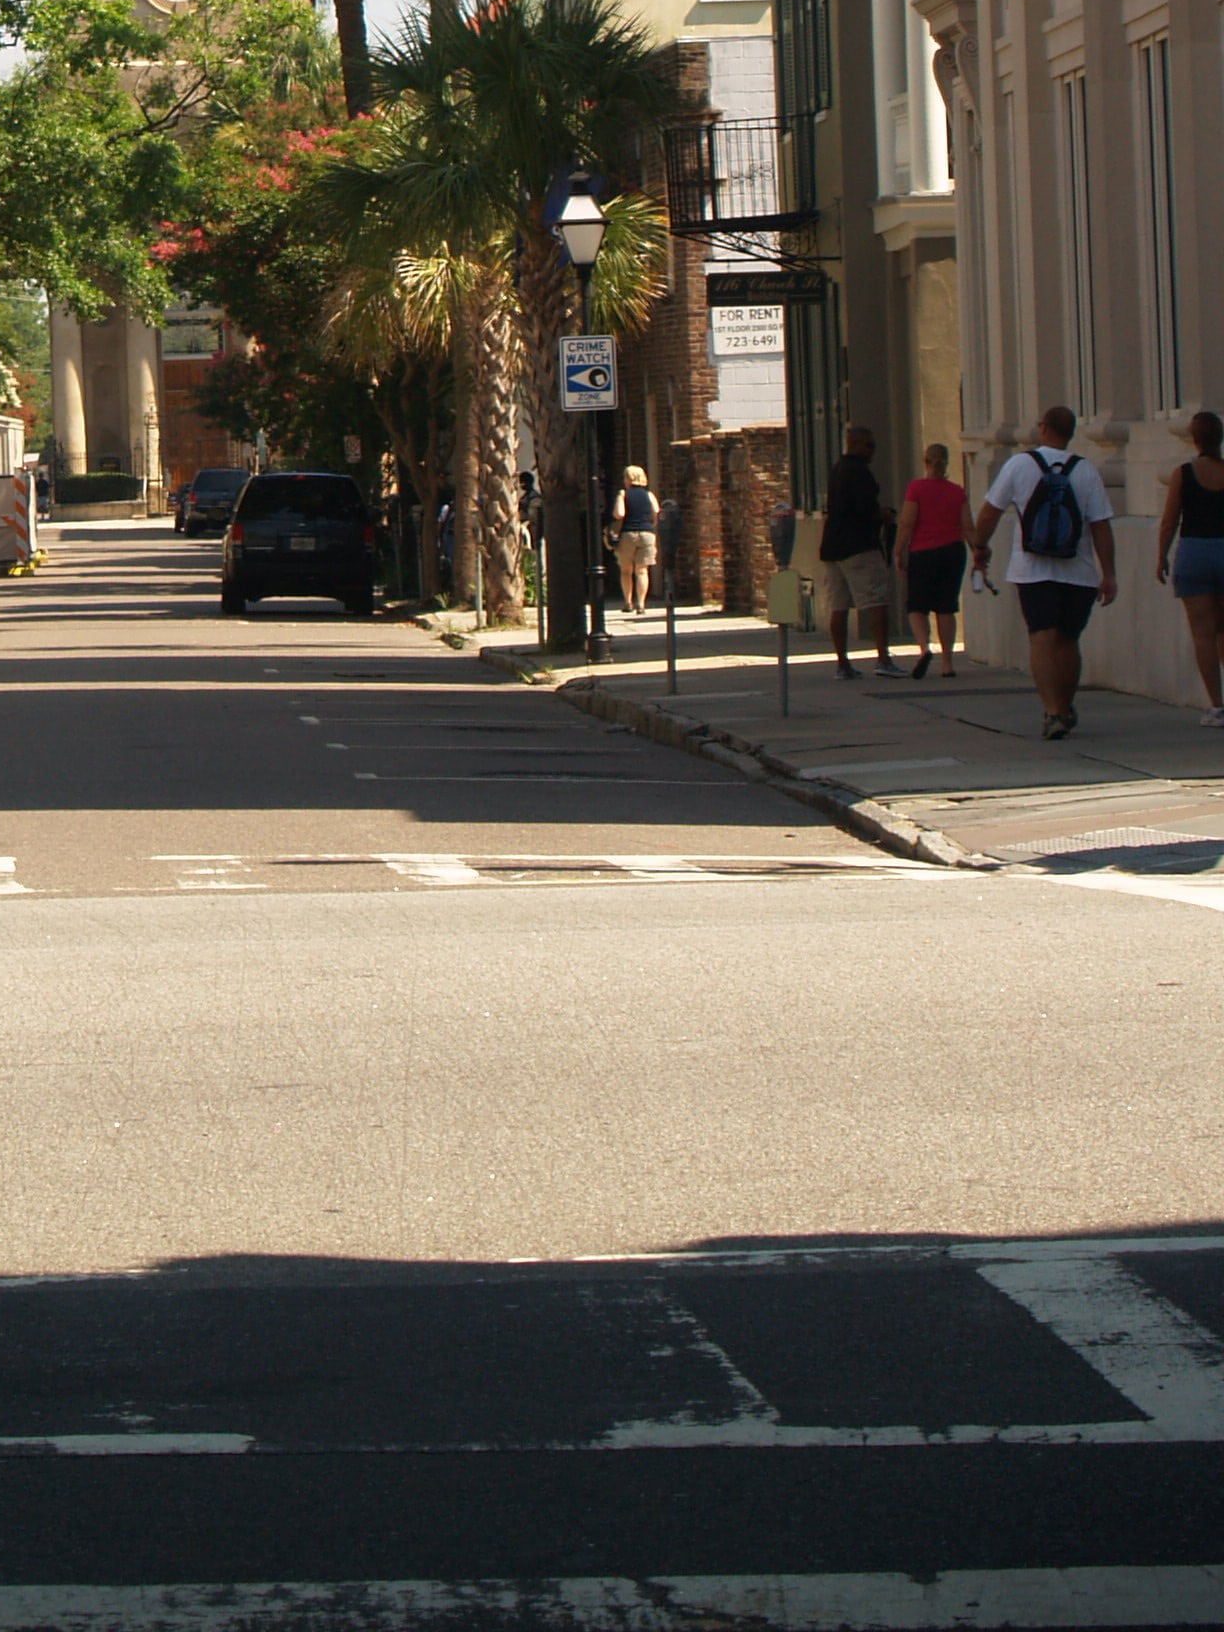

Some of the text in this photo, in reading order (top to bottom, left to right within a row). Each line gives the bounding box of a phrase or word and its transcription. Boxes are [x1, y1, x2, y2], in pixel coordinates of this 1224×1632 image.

[747, 276, 796, 289] Church
[719, 308, 781, 321] FOR RENT
[727, 324, 751, 333] FLOOR
[568, 341, 607, 352] CRIME
[566, 352, 611, 363] WATCH
[577, 392, 601, 400] ZONE
